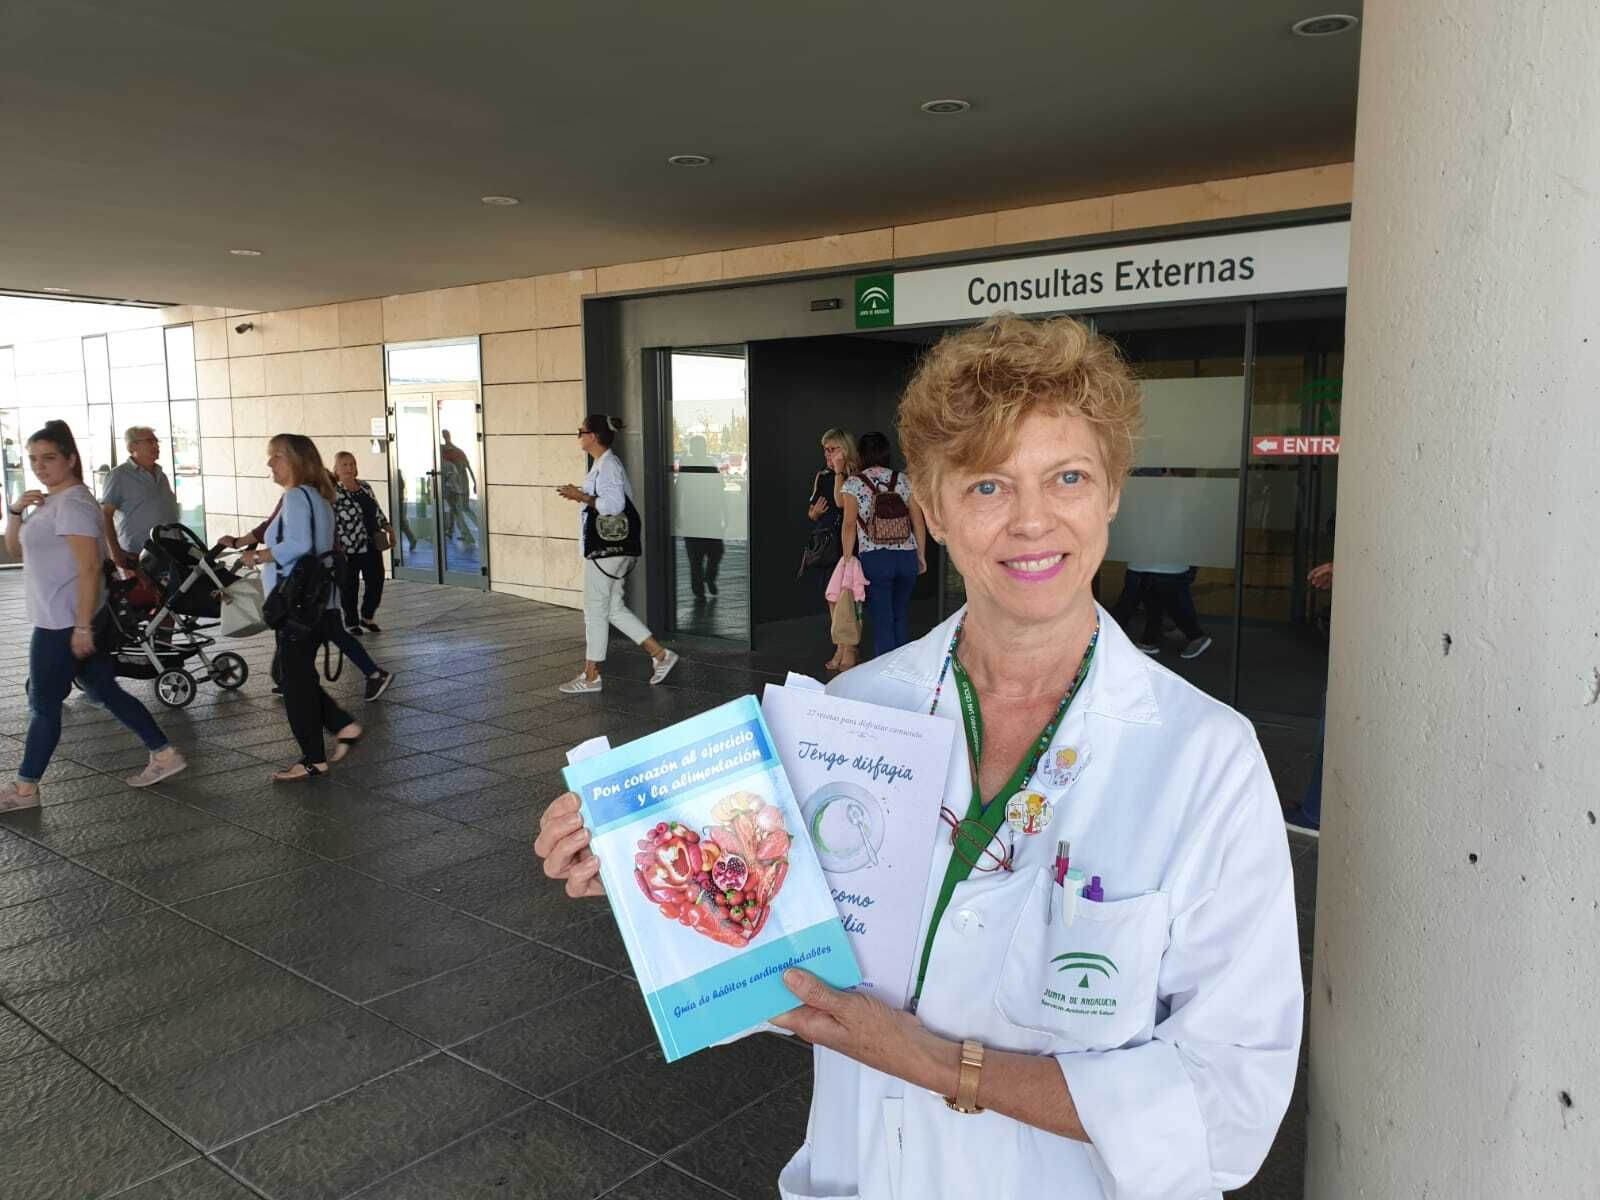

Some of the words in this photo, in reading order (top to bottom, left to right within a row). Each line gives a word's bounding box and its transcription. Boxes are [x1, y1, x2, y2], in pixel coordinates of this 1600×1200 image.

[968, 267, 1103, 306] Consultas
[1115, 255, 1255, 292] Externas
[592, 784, 622, 801] Pon
[624, 758, 679, 790] corazón
[681, 749, 698, 768] al
[702, 730, 755, 760] ejercicio
[637, 791, 648, 807] y
[651, 782, 669, 799] la
[672, 747, 762, 791] alimentación
[798, 741, 849, 771] Tengo
[852, 755, 914, 784] disfagia
[830, 888, 875, 907] como
[841, 912, 866, 935] ilia
[699, 993, 710, 1007] de
[712, 979, 748, 1001] hábitos
[749, 944, 832, 985] cardiosaludables
[1043, 988, 1066, 1002] JUNTA
[1069, 996, 1079, 1005] DE
